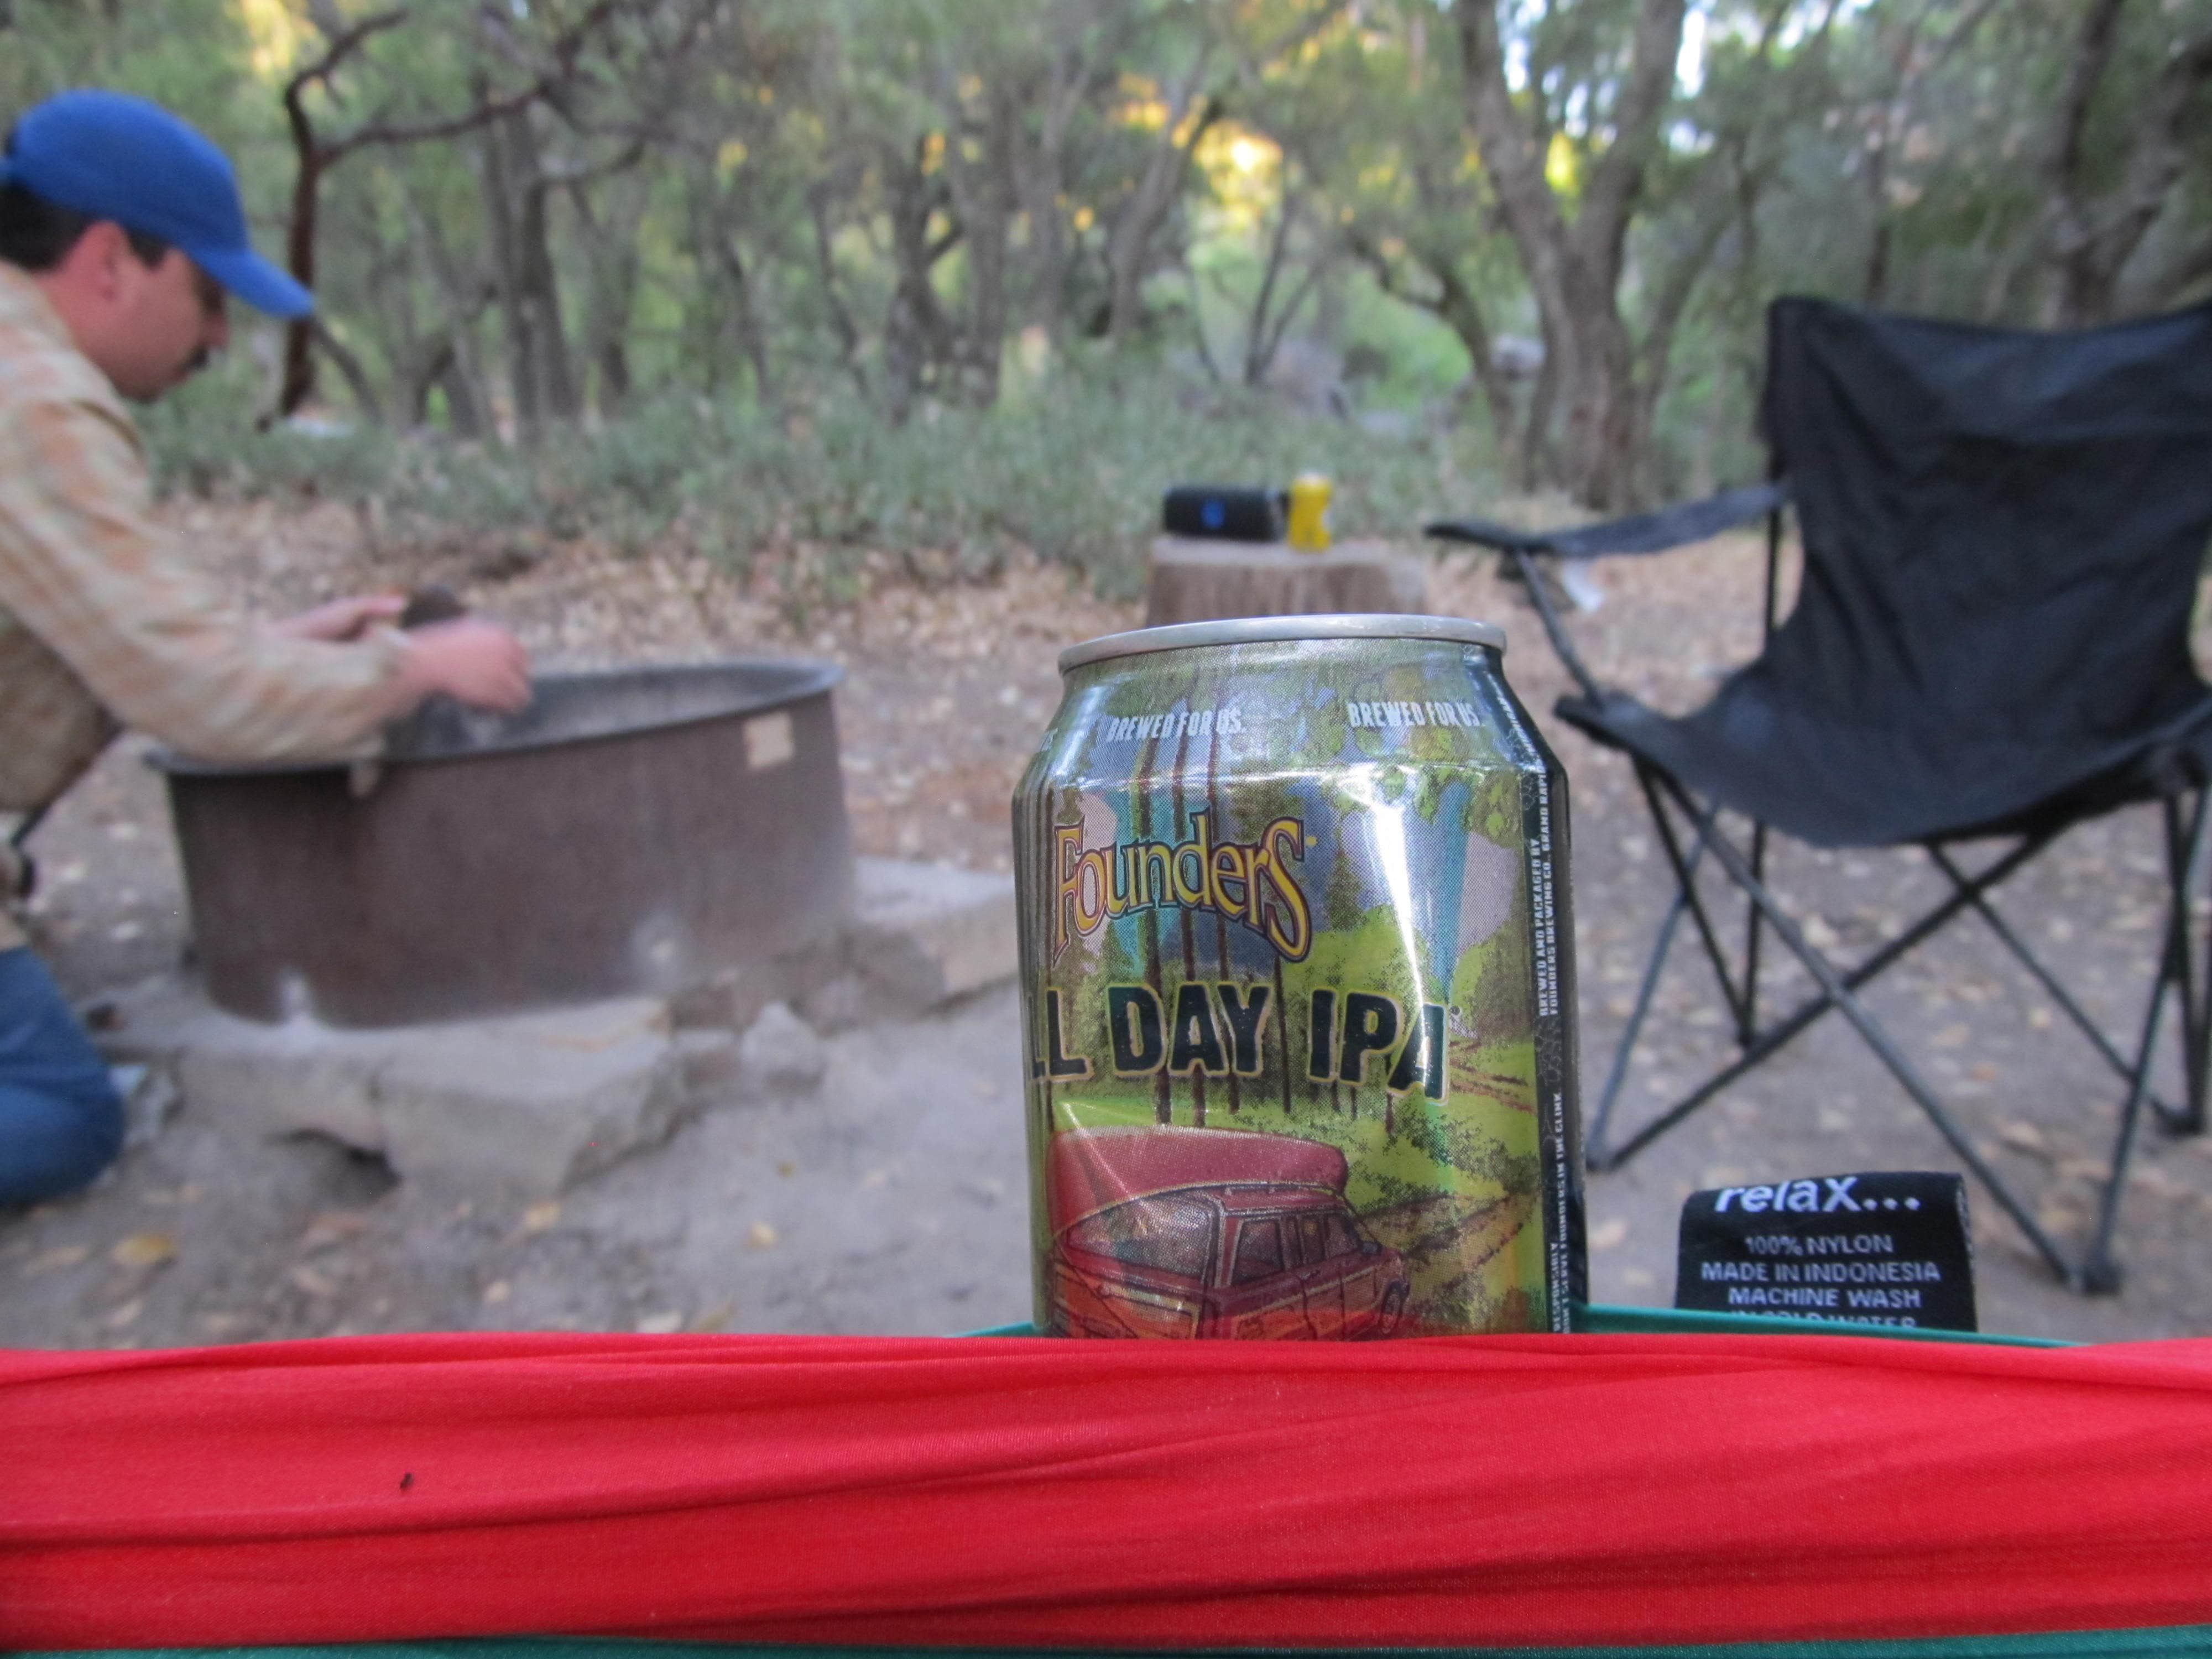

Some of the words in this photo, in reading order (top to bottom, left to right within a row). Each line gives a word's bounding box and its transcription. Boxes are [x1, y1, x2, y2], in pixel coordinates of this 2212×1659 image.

[1106, 713, 1172, 742] BREWED
[1176, 711, 1213, 738] FOR
[1347, 701, 1426, 728] BREWED
[1425, 701, 1462, 727] FOR
[1531, 858, 1544, 927] PACKAGED
[1535, 930, 1546, 957] AND
[1538, 959, 1548, 1016] BREWED
[1107, 982, 1273, 1077] DAY
[1306, 987, 1450, 1105] IPA
[1715, 1176, 1922, 1212] relax...
[1744, 1236, 1803, 1255] 100%
[1807, 1235, 1894, 1254] NYLON
[1701, 1261, 1769, 1281] MADE
[1775, 1264, 1800, 1281] IN
[1804, 1261, 1942, 1282] INDONESIA
[1728, 1287, 1839, 1307] MACHINE
[1846, 1288, 1922, 1308] WASH
